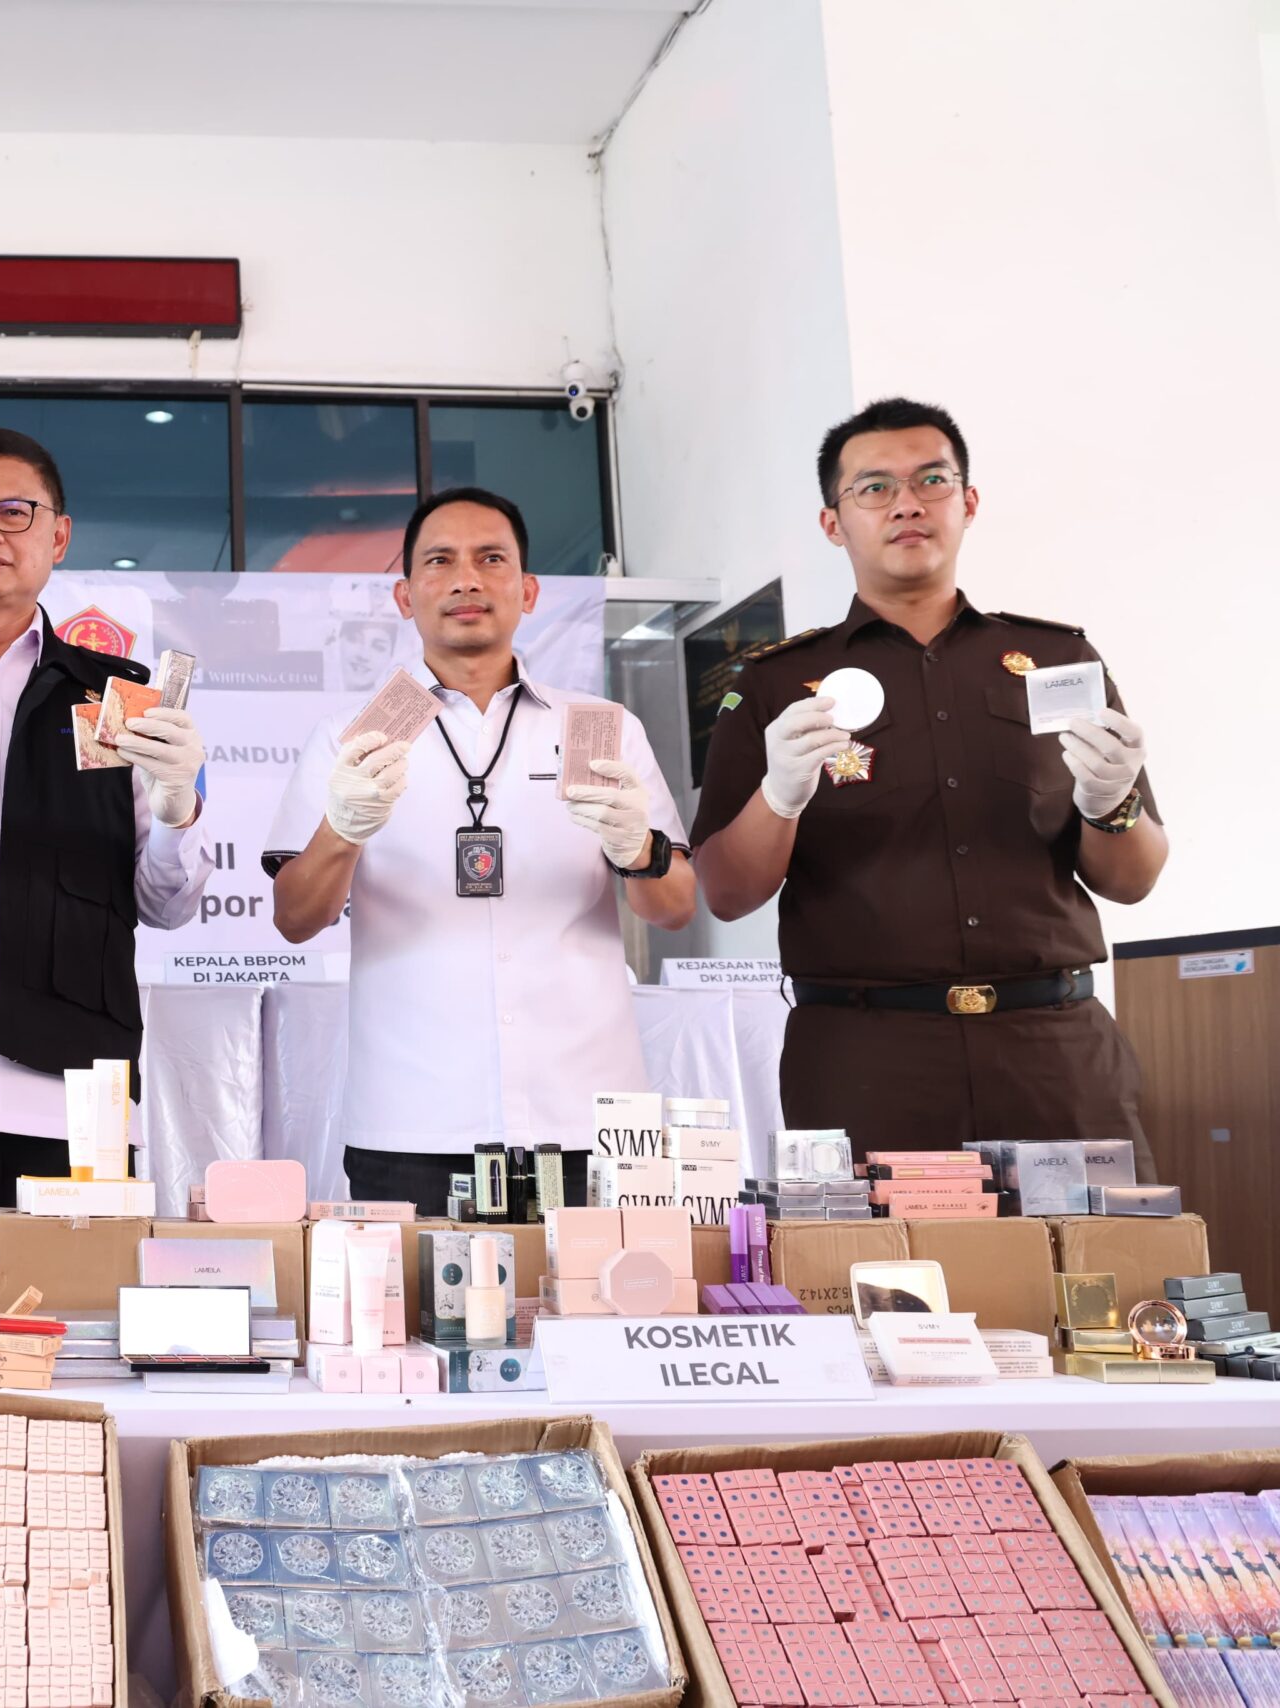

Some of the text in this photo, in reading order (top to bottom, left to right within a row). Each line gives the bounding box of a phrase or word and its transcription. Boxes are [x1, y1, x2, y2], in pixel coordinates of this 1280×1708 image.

[200, 893, 264, 924] por
[174, 955, 306, 967] KEPALA BBPOM
[676, 961, 782, 970] KEJAKSAAN TIN
[193, 971, 291, 983] DI JAKARTA
[699, 973, 784, 983] DKI JAKARTA
[597, 1127, 661, 1156] SVMY
[700, 1140, 721, 1148] SVMY
[1033, 1157, 1069, 1167] LAMEILA
[1085, 1155, 1116, 1165] MEILA
[38, 1187, 80, 1197] LAMEILA
[193, 1266, 221, 1274] LAMEILA
[623, 1323, 796, 1349] KOSMETIK
[659, 1360, 780, 1388] ILEGAL
